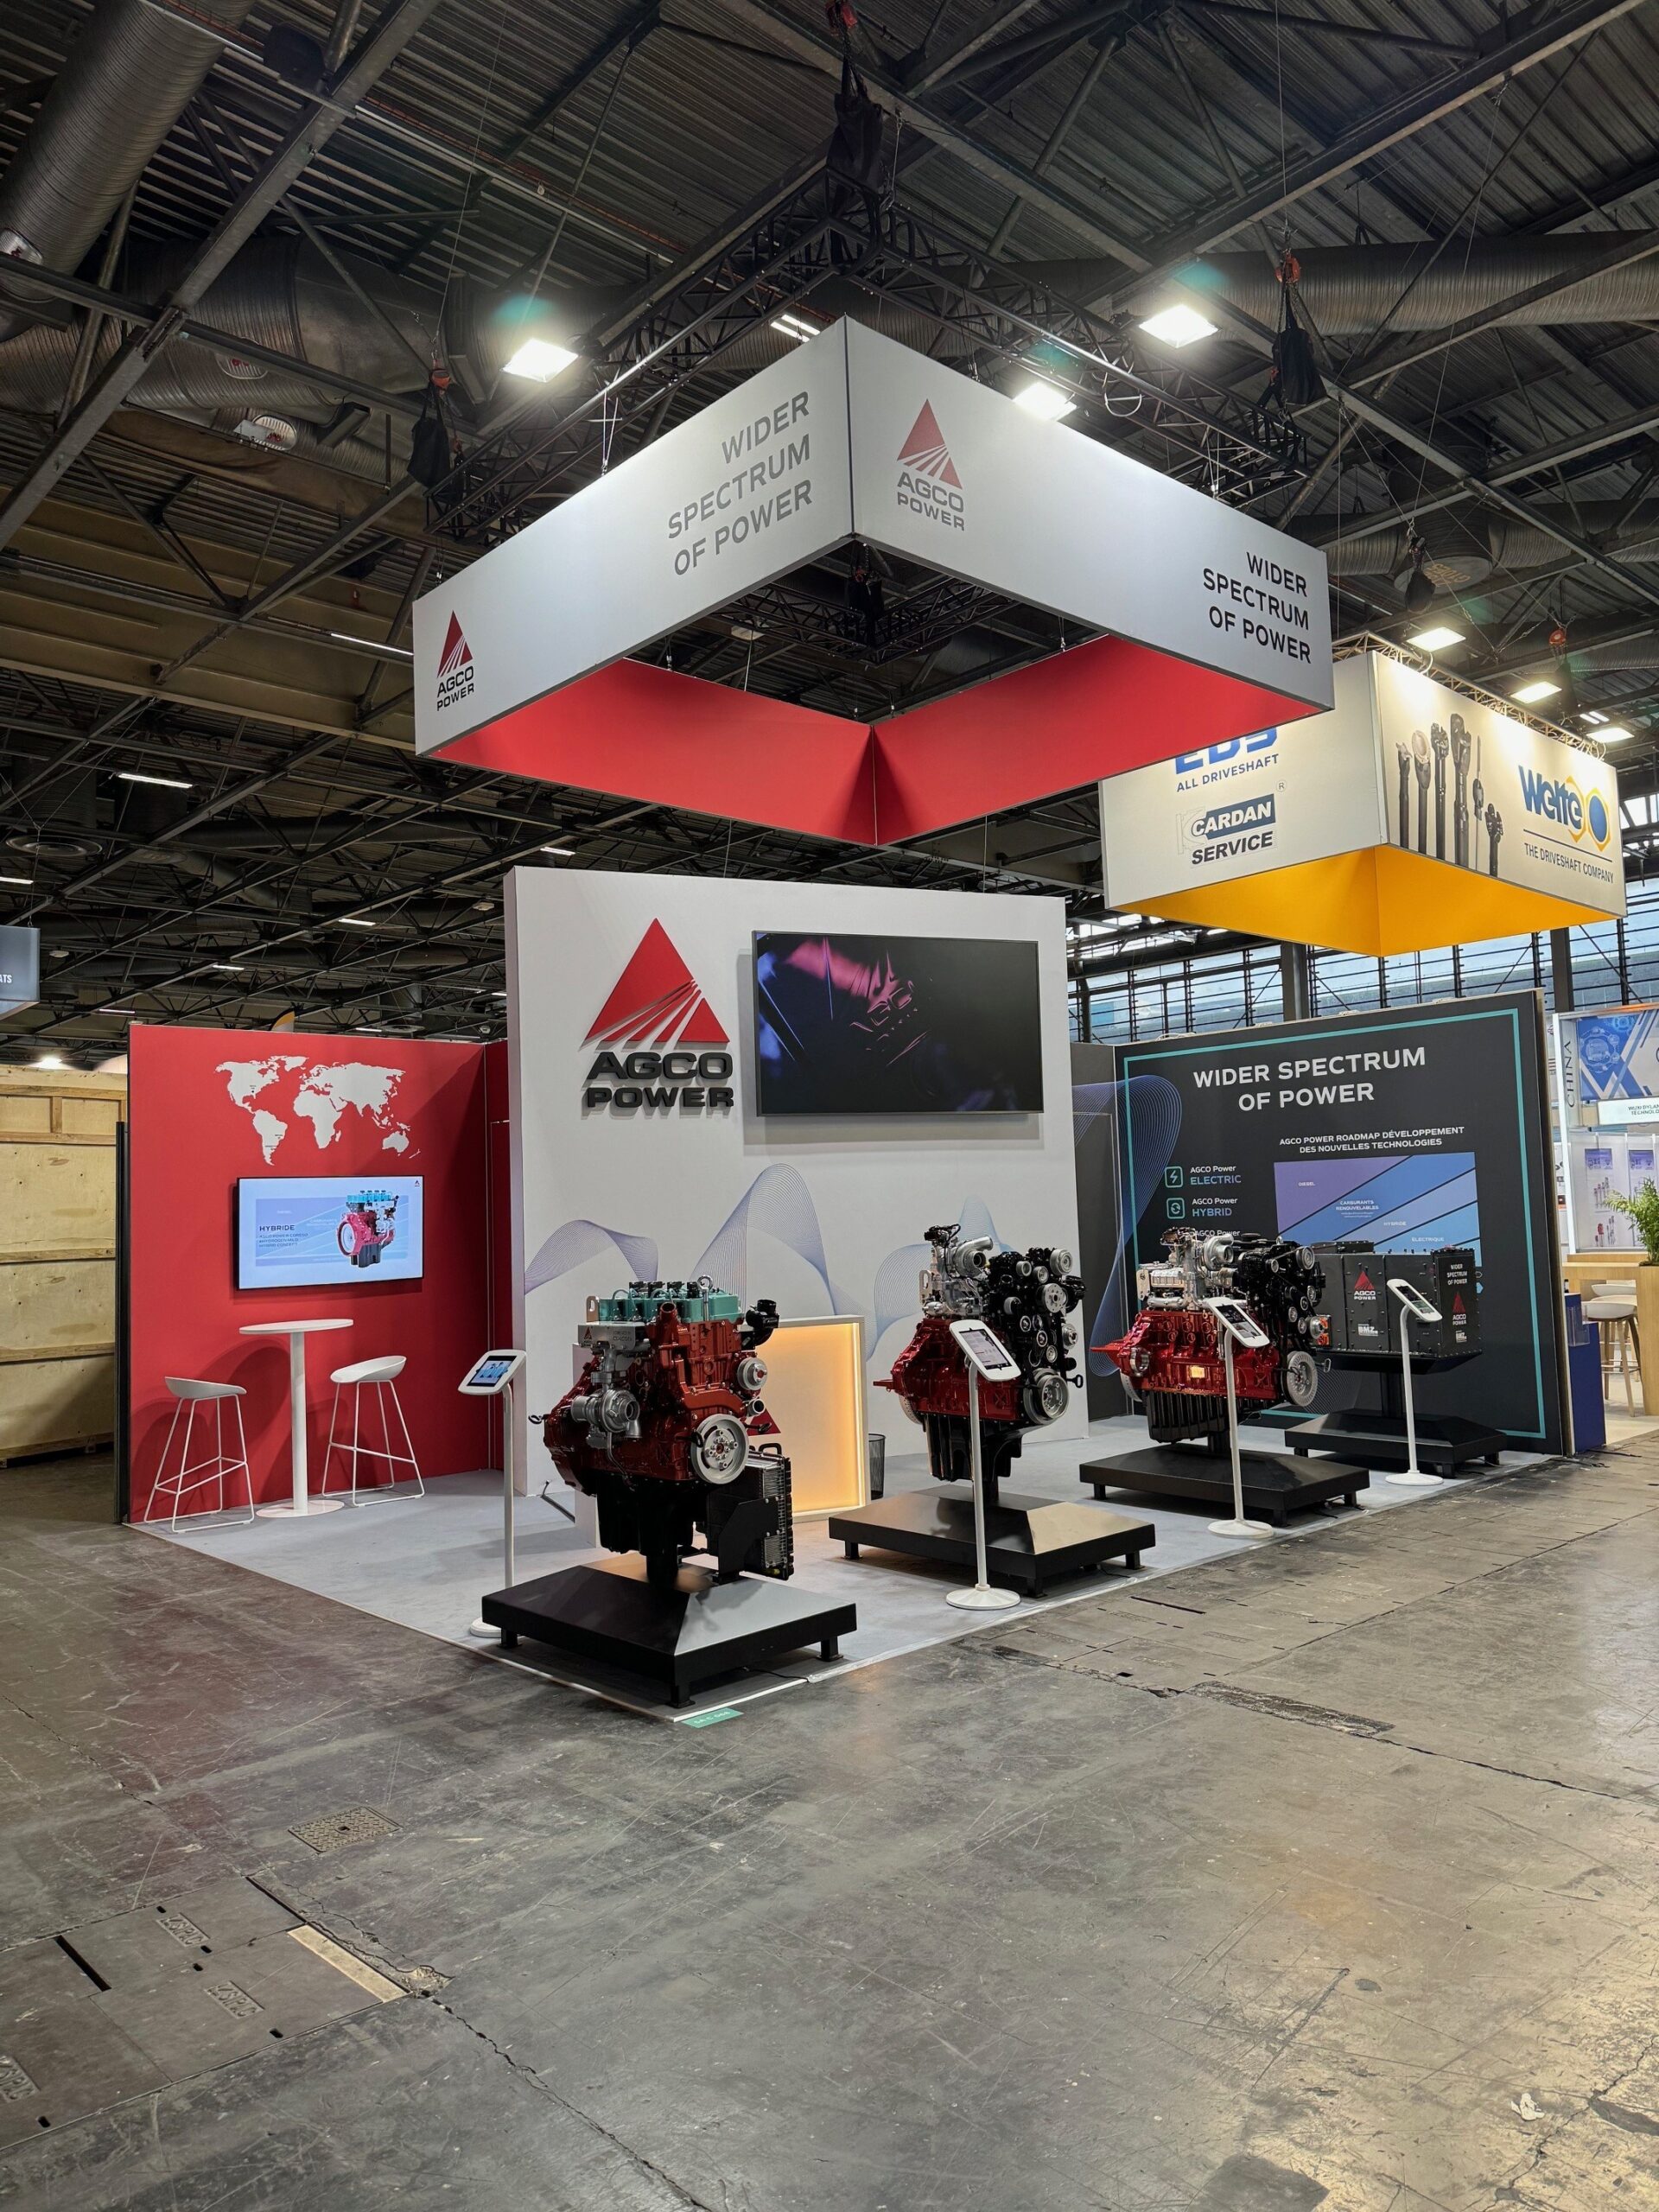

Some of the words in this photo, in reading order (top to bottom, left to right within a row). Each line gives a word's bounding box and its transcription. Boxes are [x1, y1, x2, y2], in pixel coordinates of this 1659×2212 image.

[721, 391, 810, 464] WIDER
[668, 435, 810, 539] SPECTRUM
[897, 472, 963, 512] AGCO
[674, 540, 705, 576] OF
[715, 480, 813, 555] POWER
[897, 492, 964, 531] POWER
[1246, 551, 1306, 597] WIDER
[1203, 568, 1309, 631] SPECTRUM
[1211, 607, 1236, 632] OF
[1243, 619, 1311, 664] POWER
[437, 665, 474, 698] AGCO
[437, 683, 474, 711] POWER
[1177, 778, 1198, 792] ALL
[1202, 753, 1279, 785] DRIVESHAFT
[1518, 765, 1583, 830] Welte
[1191, 802, 1271, 837] CARDAN
[1192, 831, 1274, 865] SERVICE
[1524, 842, 1539, 859] THE
[1540, 848, 1581, 873] DRIVESHAFT
[1583, 863, 1614, 883] COMPANY
[587, 1051, 734, 1080] AGCO
[1193, 1064, 1270, 1088] WIDER
[1278, 1046, 1426, 1079] SPECTRUM
[1564, 1040, 1575, 1107] CHINA
[587, 1087, 734, 1108] POWER
[1238, 1093, 1270, 1111] OF
[1279, 1083, 1375, 1109] POWER
[1319, 1142, 1370, 1153] NOUVELLES
[1371, 1138, 1442, 1149] TECHNOLOGIES
[1336, 1132, 1380, 1142] ROADMAP
[1382, 1126, 1465, 1139] DÉVELOPPEMENT
[1191, 1175, 1241, 1185] ELECTRIC
[1192, 1208, 1232, 1217] HYBRID
